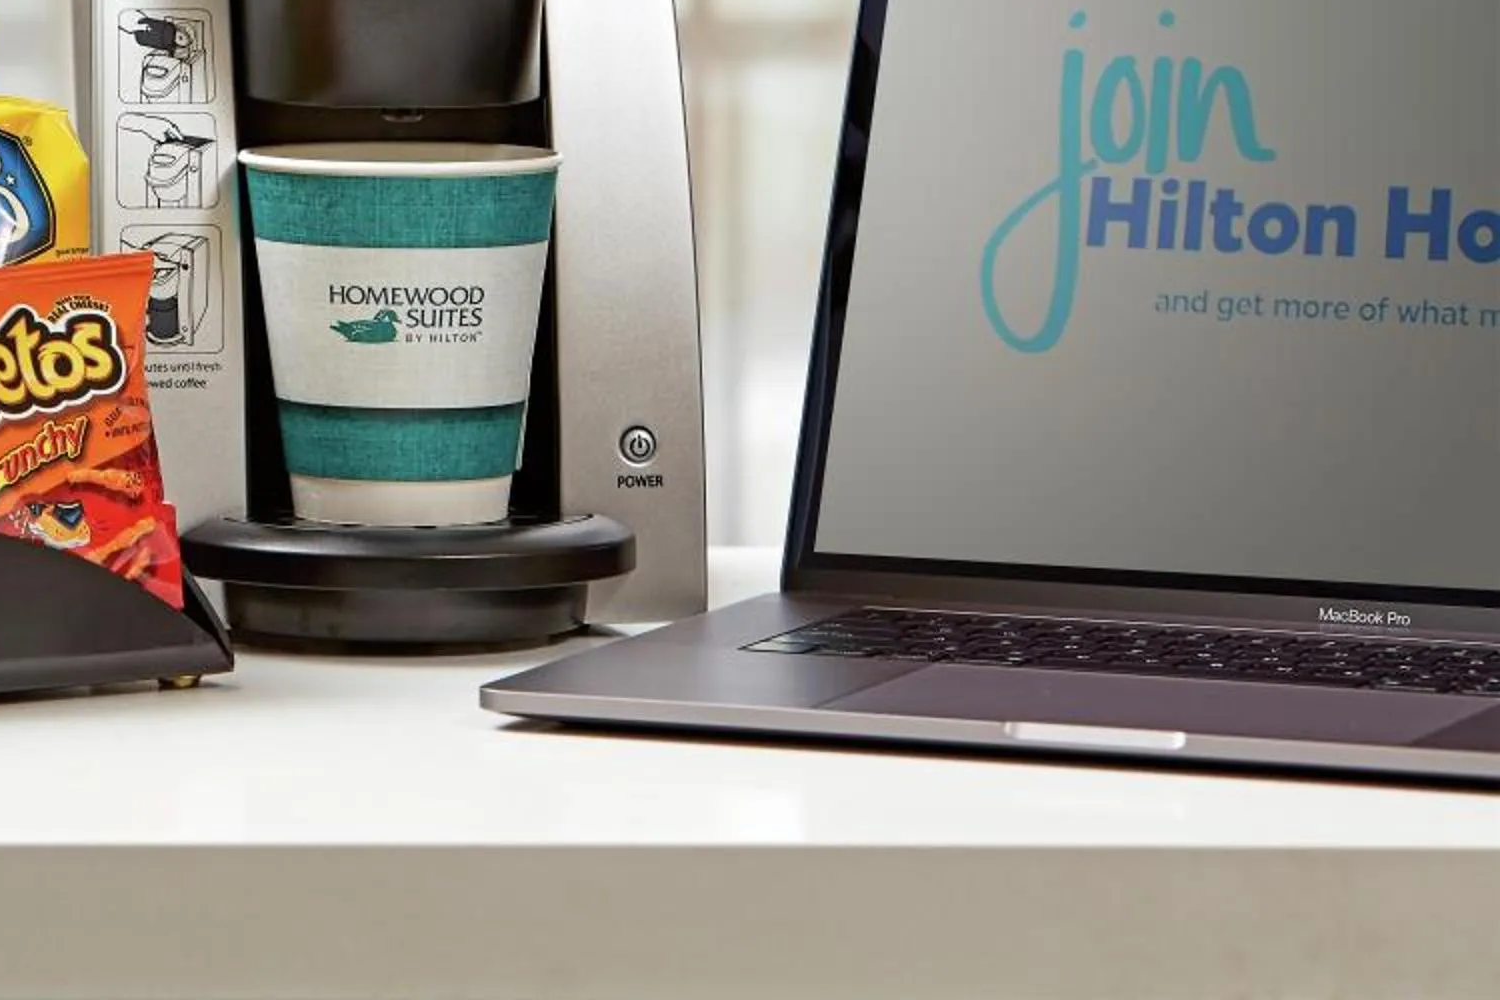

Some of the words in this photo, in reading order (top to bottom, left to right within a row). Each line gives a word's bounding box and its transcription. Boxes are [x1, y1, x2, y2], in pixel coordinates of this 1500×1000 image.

[980, 9, 1277, 353] join
[1086, 176, 1357, 257] Hilton
[1385, 186, 1500, 263] Ho
[328, 284, 486, 307] HOMEWOOD
[1155, 289, 1209, 315] and
[1217, 294, 1264, 322] get
[1273, 300, 1350, 321] more
[1358, 297, 1391, 322] of
[1397, 301, 1470, 327] what
[405, 308, 484, 329] SUITES
[405, 334, 422, 343] BY
[429, 332, 478, 343] HILTON
[145, 363, 168, 373] utes
[174, 378, 207, 389] coffee
[617, 475, 664, 488] POWER
[1318, 607, 1384, 625] MacBook
[1387, 611, 1412, 626] Pro
